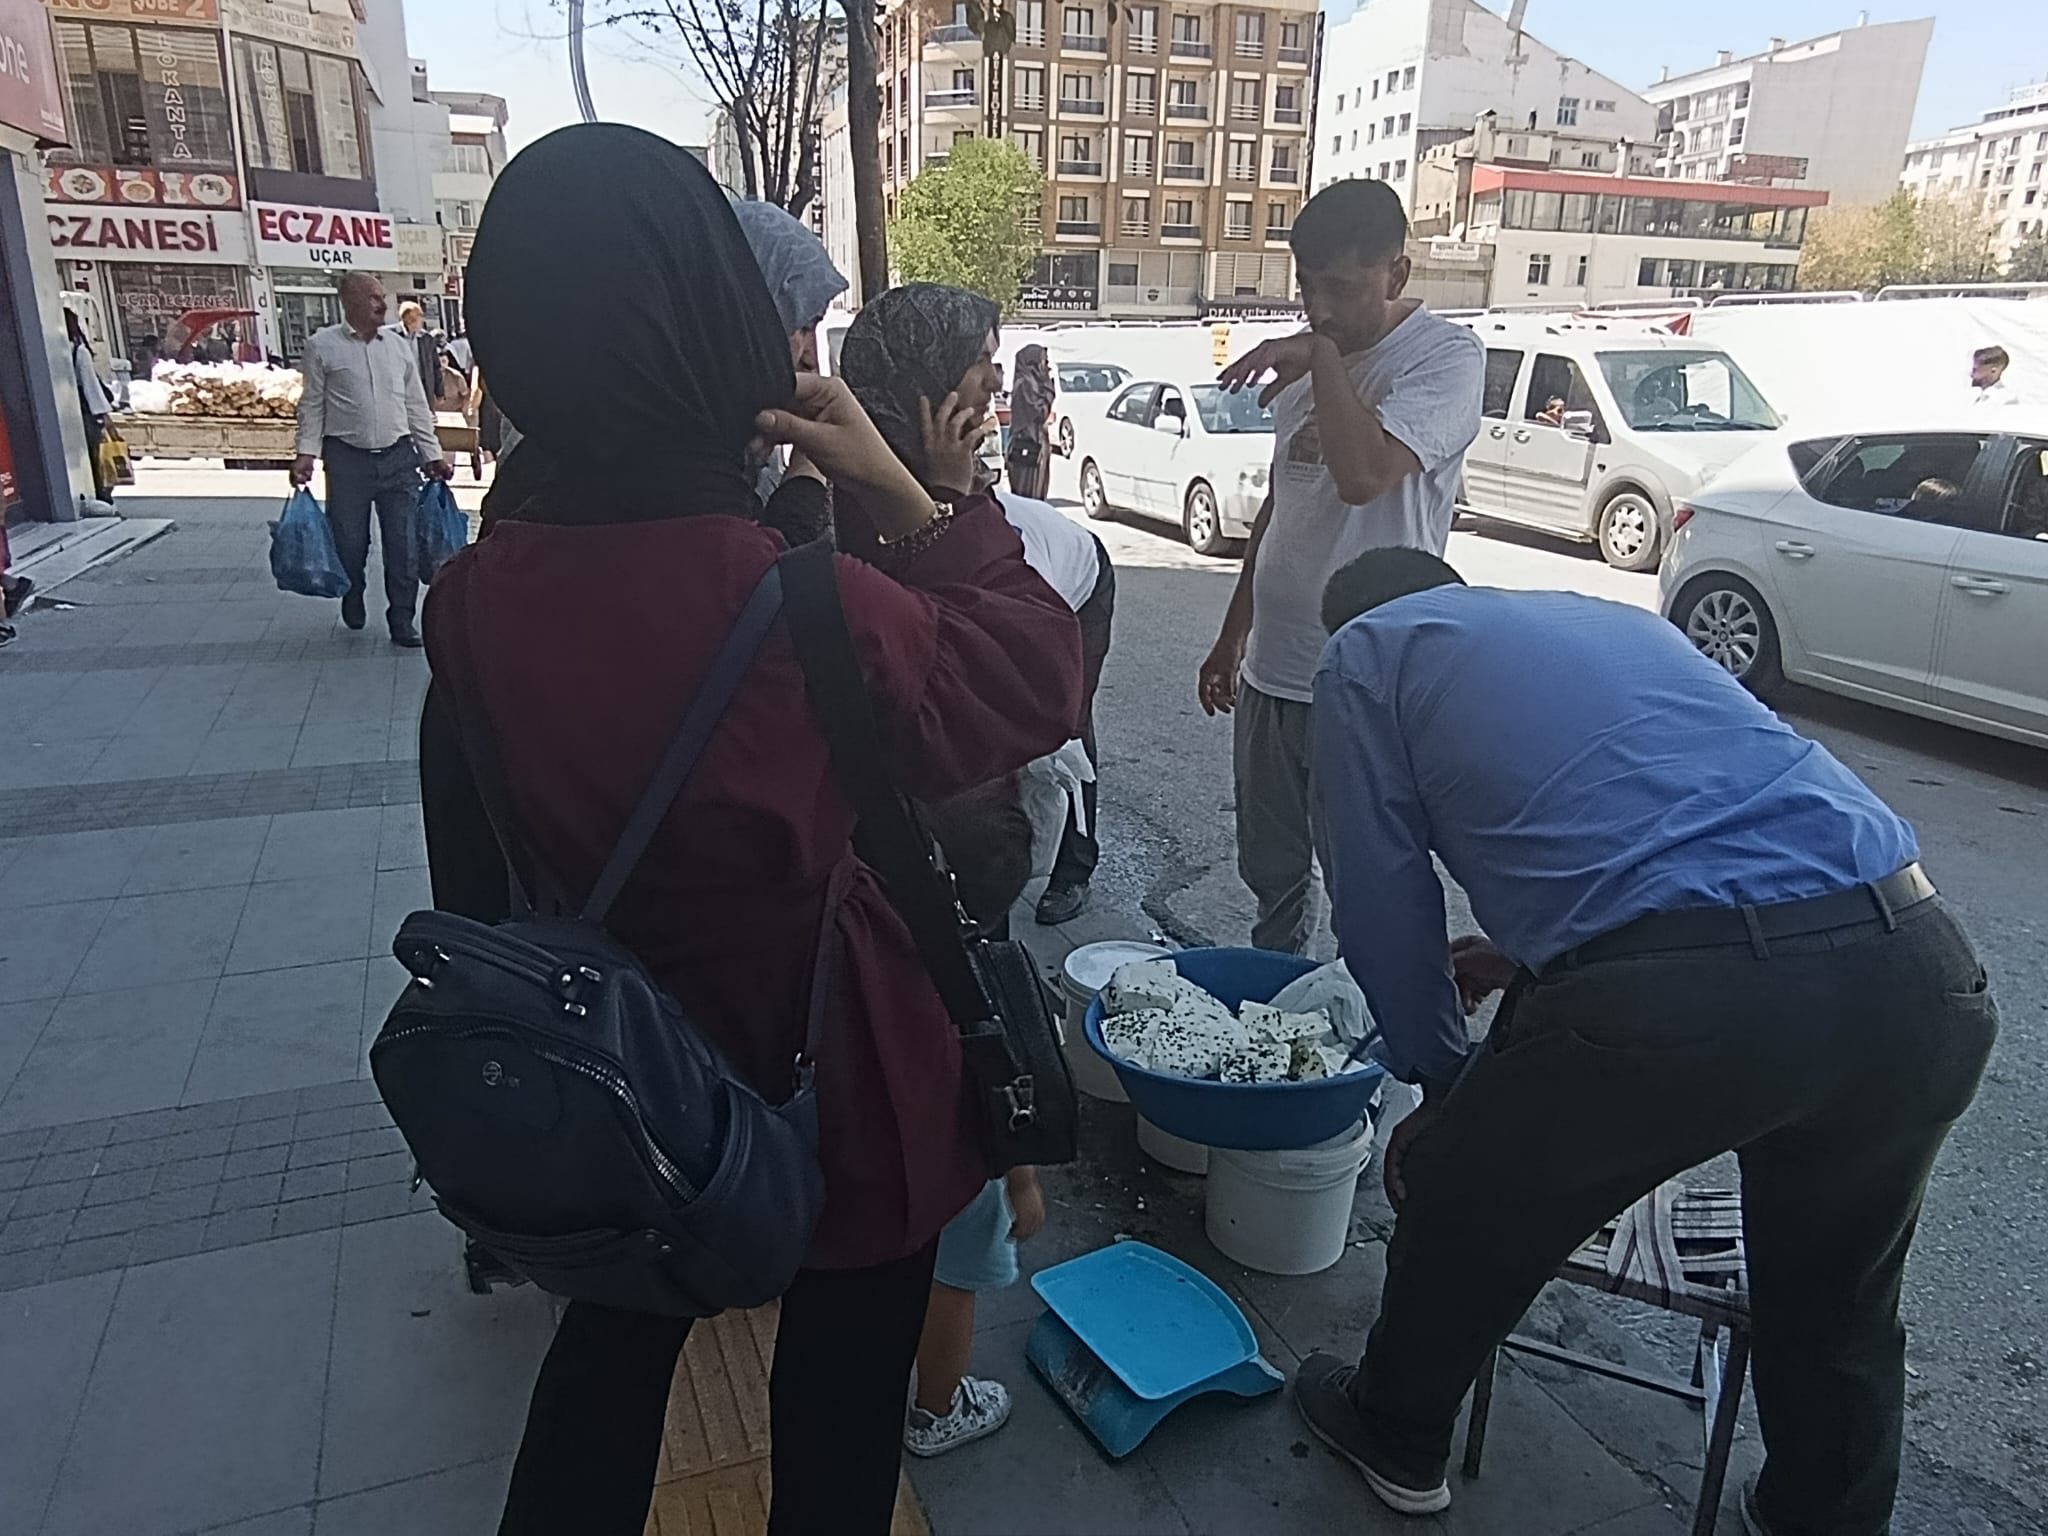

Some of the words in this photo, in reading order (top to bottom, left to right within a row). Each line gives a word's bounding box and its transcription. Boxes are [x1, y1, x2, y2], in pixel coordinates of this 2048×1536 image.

[157, 33, 192, 158] LOKANTA
[257, 207, 393, 249] ECZANE
[309, 248, 353, 266] UÇAR
